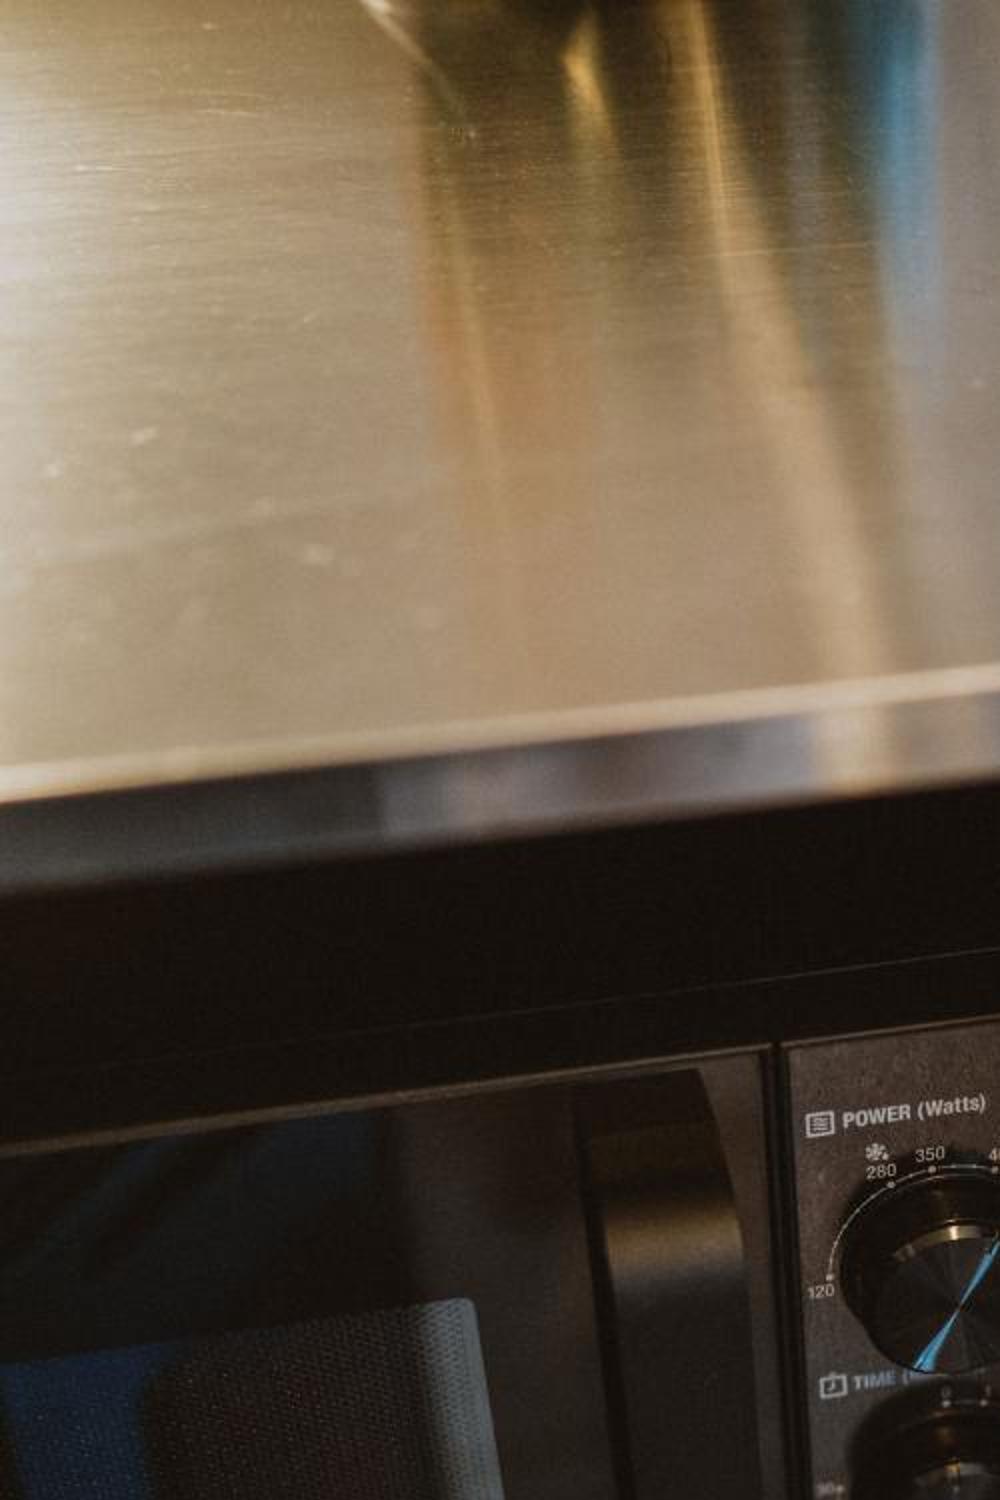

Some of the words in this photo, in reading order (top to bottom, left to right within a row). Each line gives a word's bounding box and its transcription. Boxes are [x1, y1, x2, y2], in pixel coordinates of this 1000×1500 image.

[842, 1103, 911, 1129] POWER
[917, 1093, 987, 1121] (Watts)
[915, 1145, 945, 1162] 350
[866, 1163, 897, 1180] 280
[807, 1283, 835, 1299] 120
[854, 1369, 897, 1391] TIME
